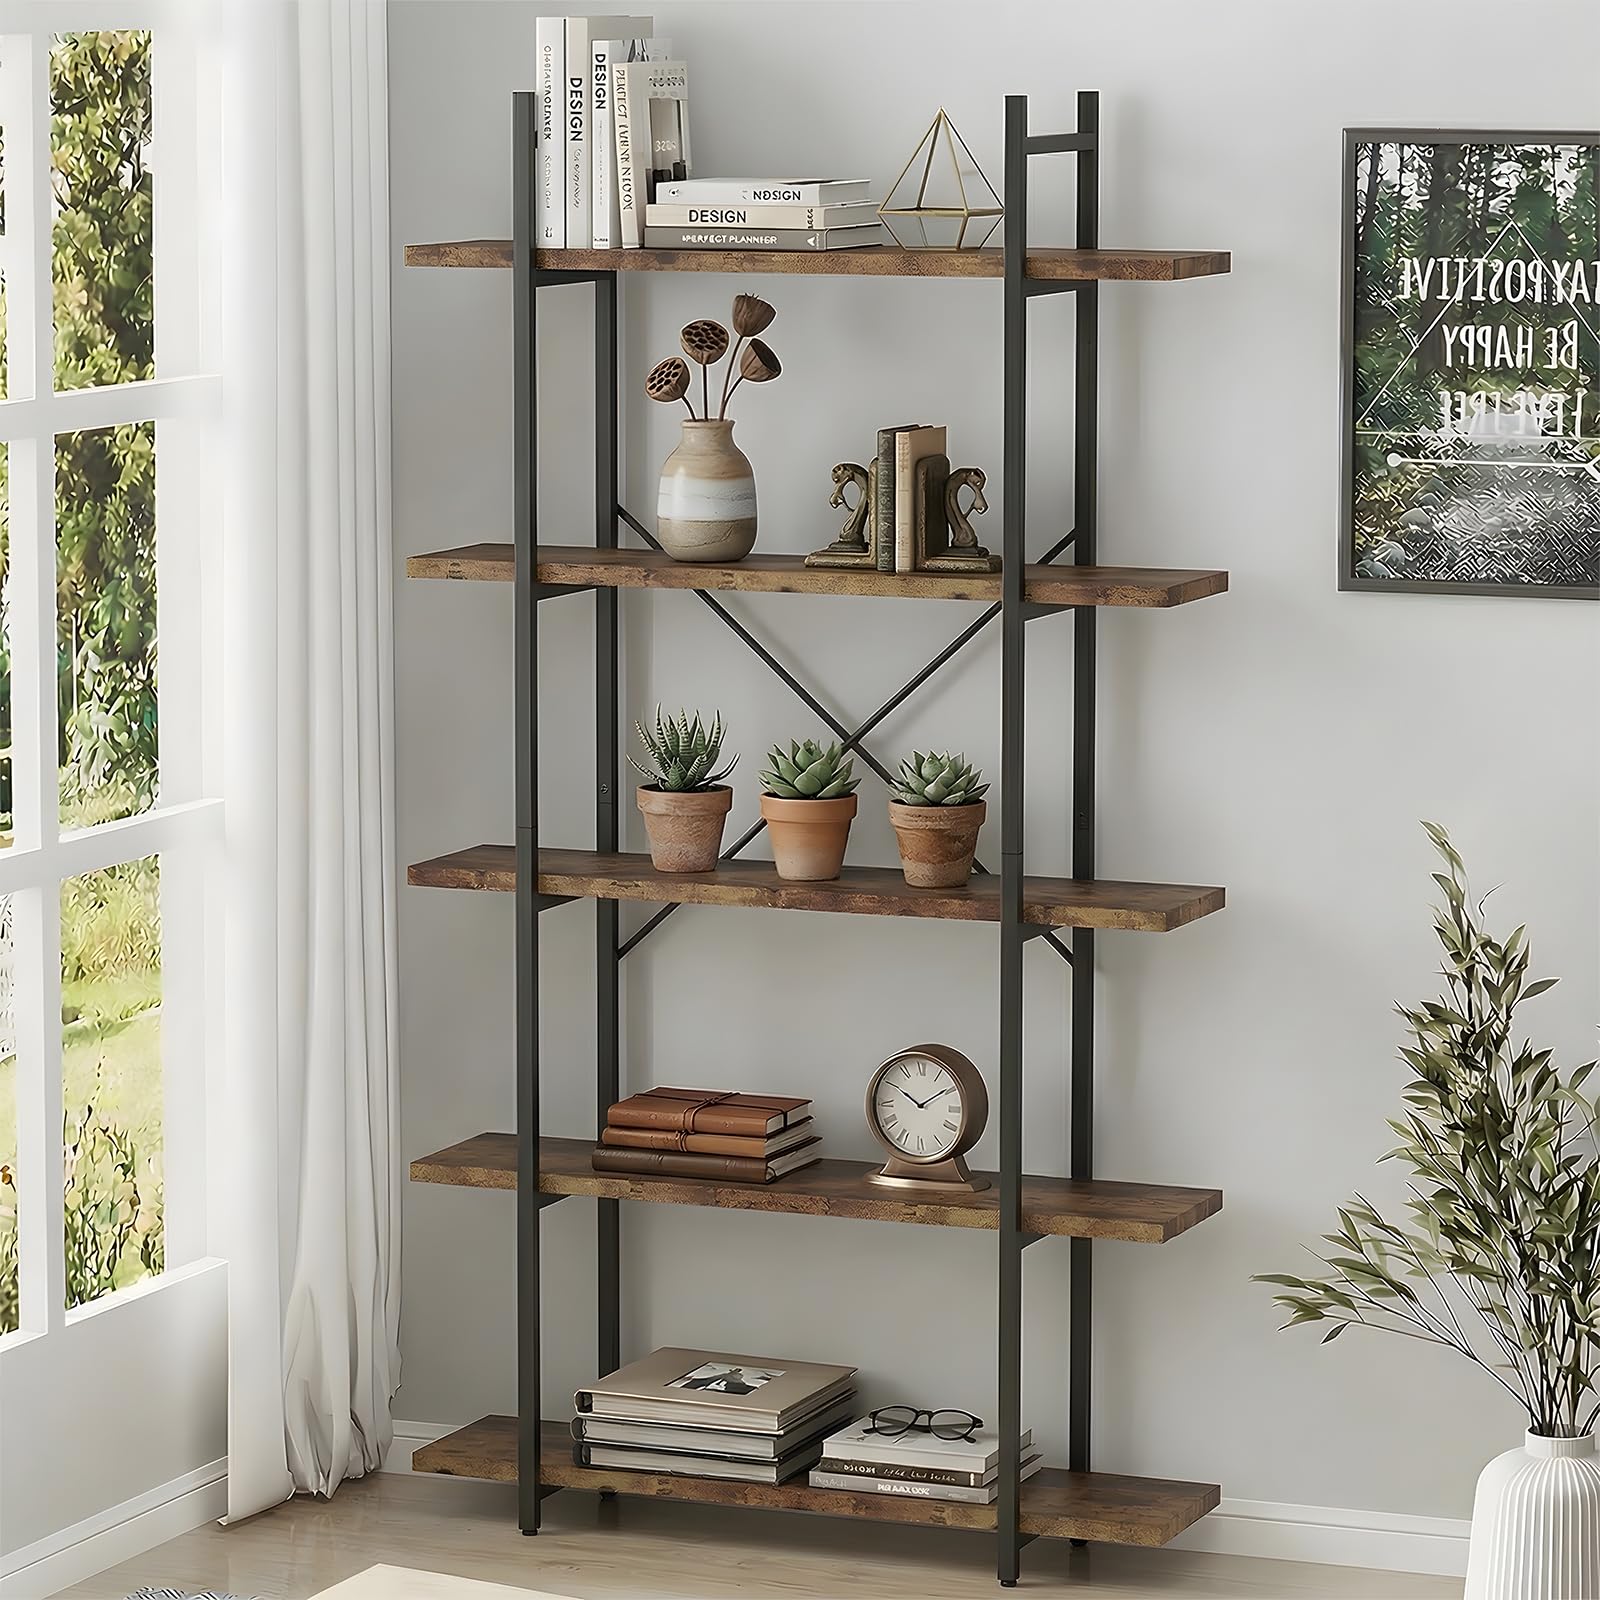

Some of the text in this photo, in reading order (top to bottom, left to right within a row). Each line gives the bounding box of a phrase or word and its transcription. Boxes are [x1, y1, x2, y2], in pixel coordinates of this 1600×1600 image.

[570, 77, 583, 142] DESIGN
[594, 53, 607, 110] DESIGN
[688, 209, 747, 224] DESIGN
